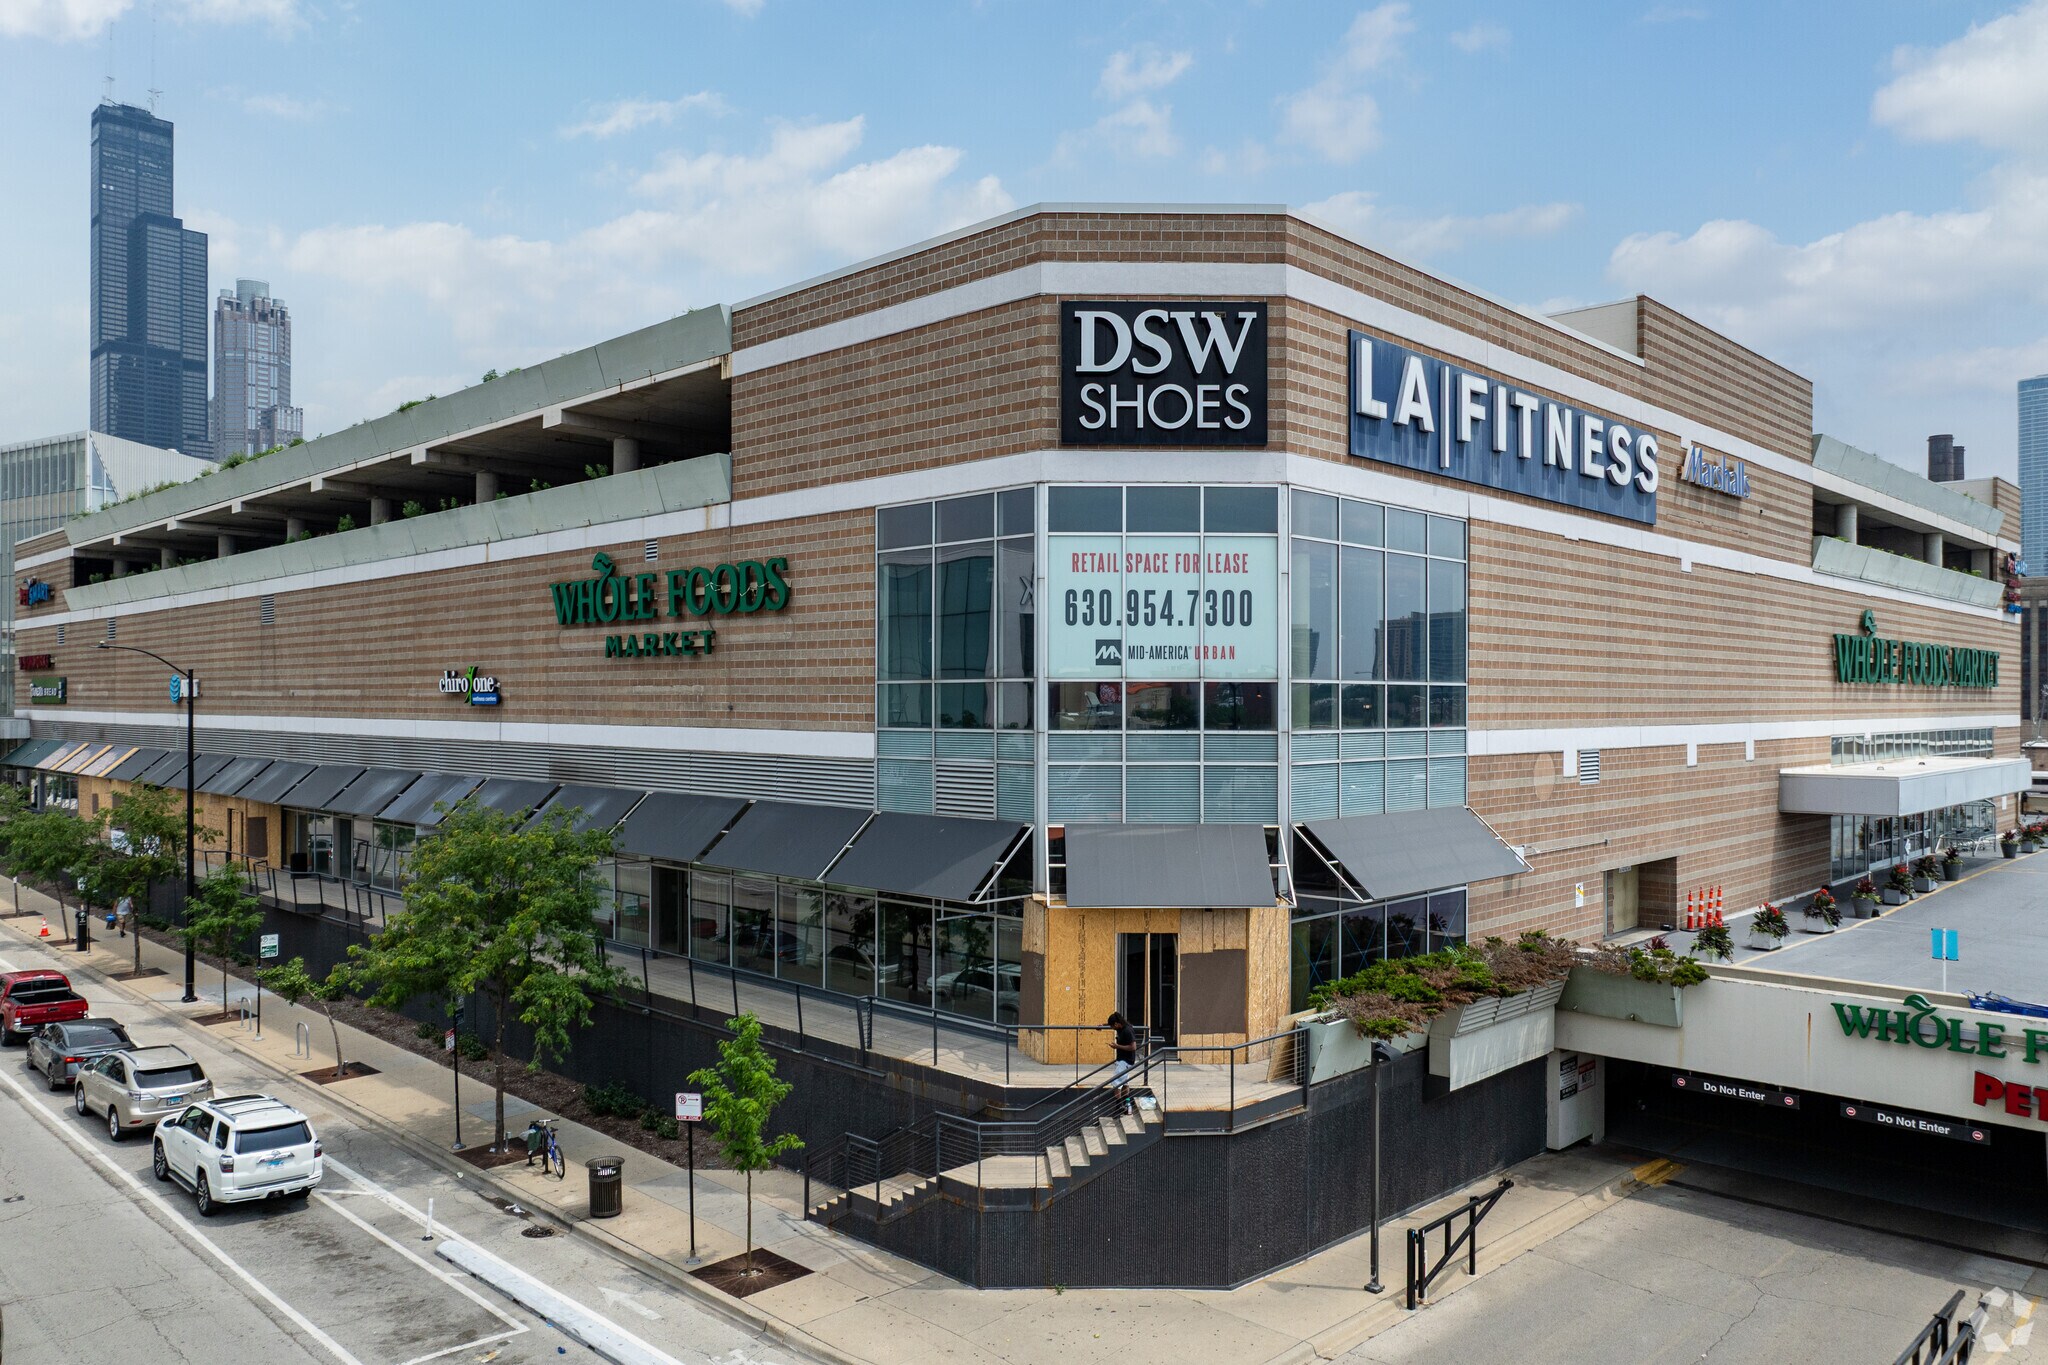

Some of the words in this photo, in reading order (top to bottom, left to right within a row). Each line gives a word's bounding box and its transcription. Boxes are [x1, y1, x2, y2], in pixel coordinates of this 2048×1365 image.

[1075, 309, 1257, 375] DSW
[1079, 382, 1252, 430] SHOES
[1355, 337, 1435, 433] LA
[1456, 372, 1659, 494] FITNESS
[1681, 446, 1751, 498] Marshalls
[1071, 552, 1119, 573] RETAIL
[1126, 552, 1169, 573] SPACE
[1175, 552, 1200, 574] FOR
[1207, 553, 1249, 574] LEASE
[550, 554, 659, 625] WHOLE
[665, 557, 791, 618] FOODS
[1065, 588, 1253, 627] 630.954.7300
[605, 630, 716, 658] MARKET
[1194, 646, 1236, 660] URBAN
[1833, 618, 1898, 684] WHOLE
[1901, 641, 1950, 686] FOODS
[1951, 646, 2000, 687] MARKET
[473, 677, 495, 693] one
[1831, 996, 2007, 1059] WHOLE
[1703, 1082, 1717, 1092] Do
[1719, 1085, 1737, 1096] Not
[1739, 1088, 1765, 1101] Enter
[1877, 1112, 1893, 1124] Do
[1896, 1116, 1916, 1129] Not
[1918, 1120, 1950, 1135] Enter
